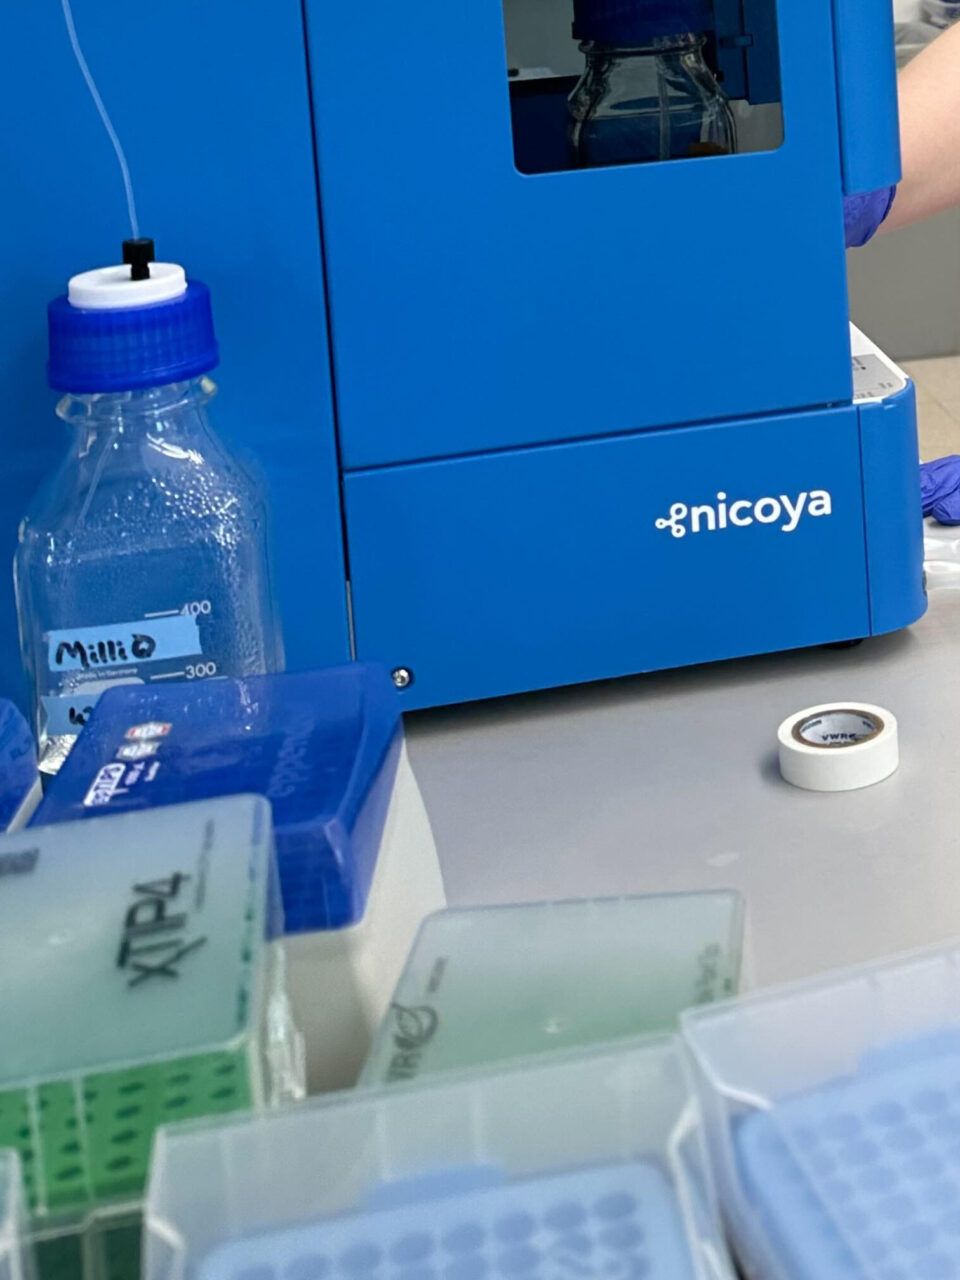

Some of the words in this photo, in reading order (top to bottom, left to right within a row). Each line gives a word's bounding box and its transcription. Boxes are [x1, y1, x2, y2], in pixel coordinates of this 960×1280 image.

[691, 489, 832, 532] nicoya
[180, 600, 212, 616] 400
[186, 662, 217, 679] 300
[821, 732, 849, 741] VWR
